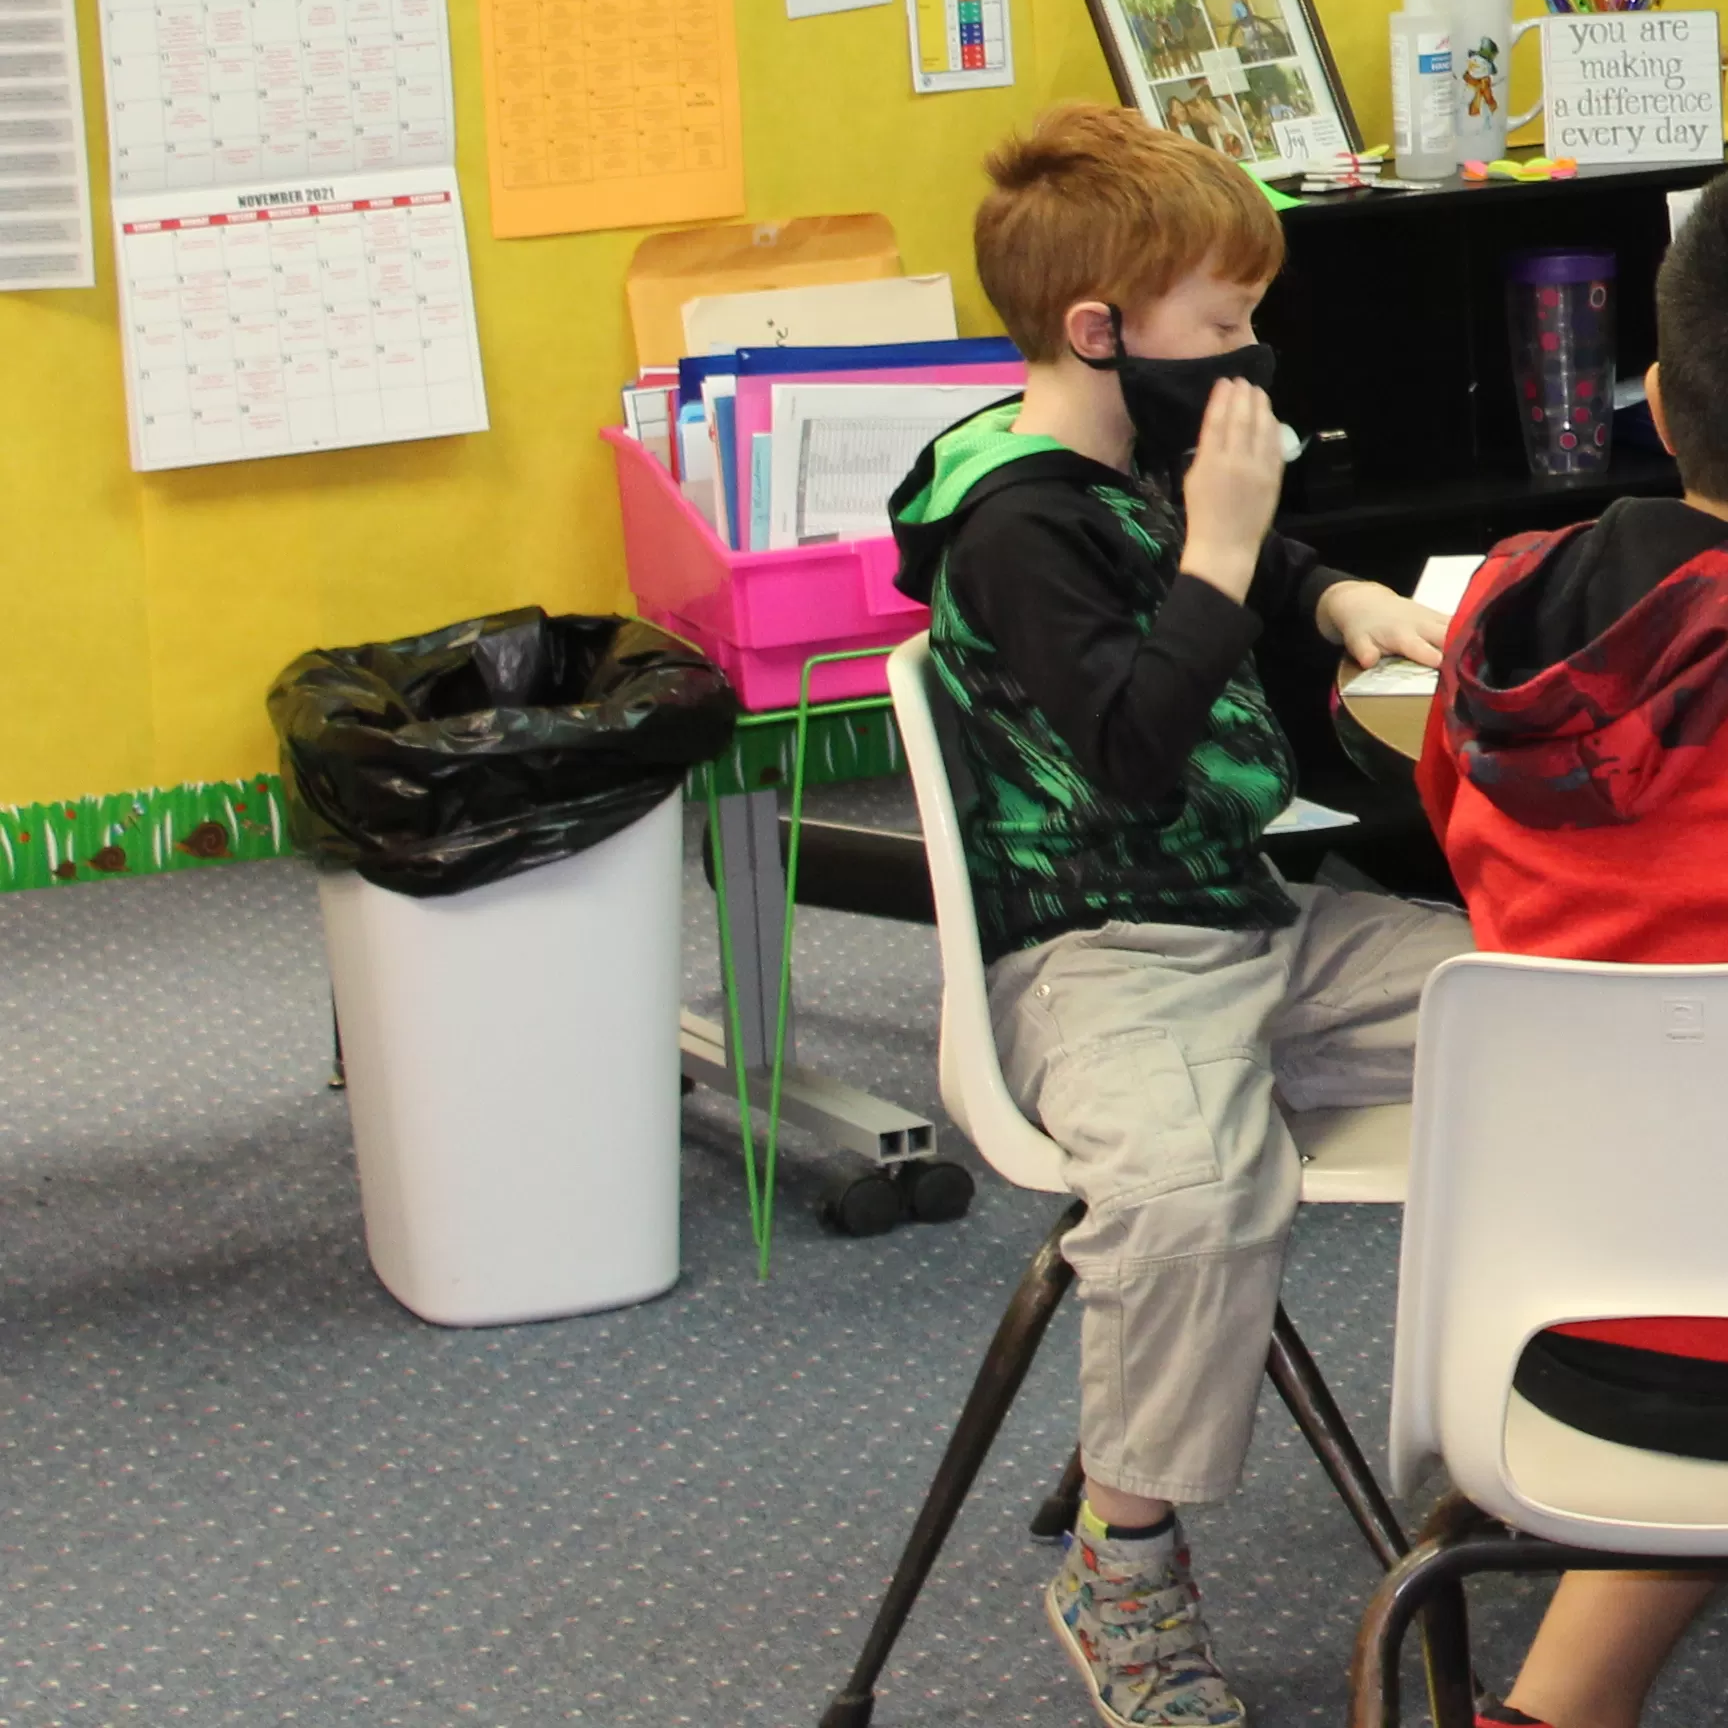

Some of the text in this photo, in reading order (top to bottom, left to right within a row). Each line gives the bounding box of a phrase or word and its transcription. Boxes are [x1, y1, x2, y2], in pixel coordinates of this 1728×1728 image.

[1569, 18, 1690, 55] you are
[1580, 52, 1684, 90] making
[1555, 87, 1712, 116] a difference
[1561, 121, 1708, 152] every day
[237, 187, 335, 209] NOVEMBER 2021
